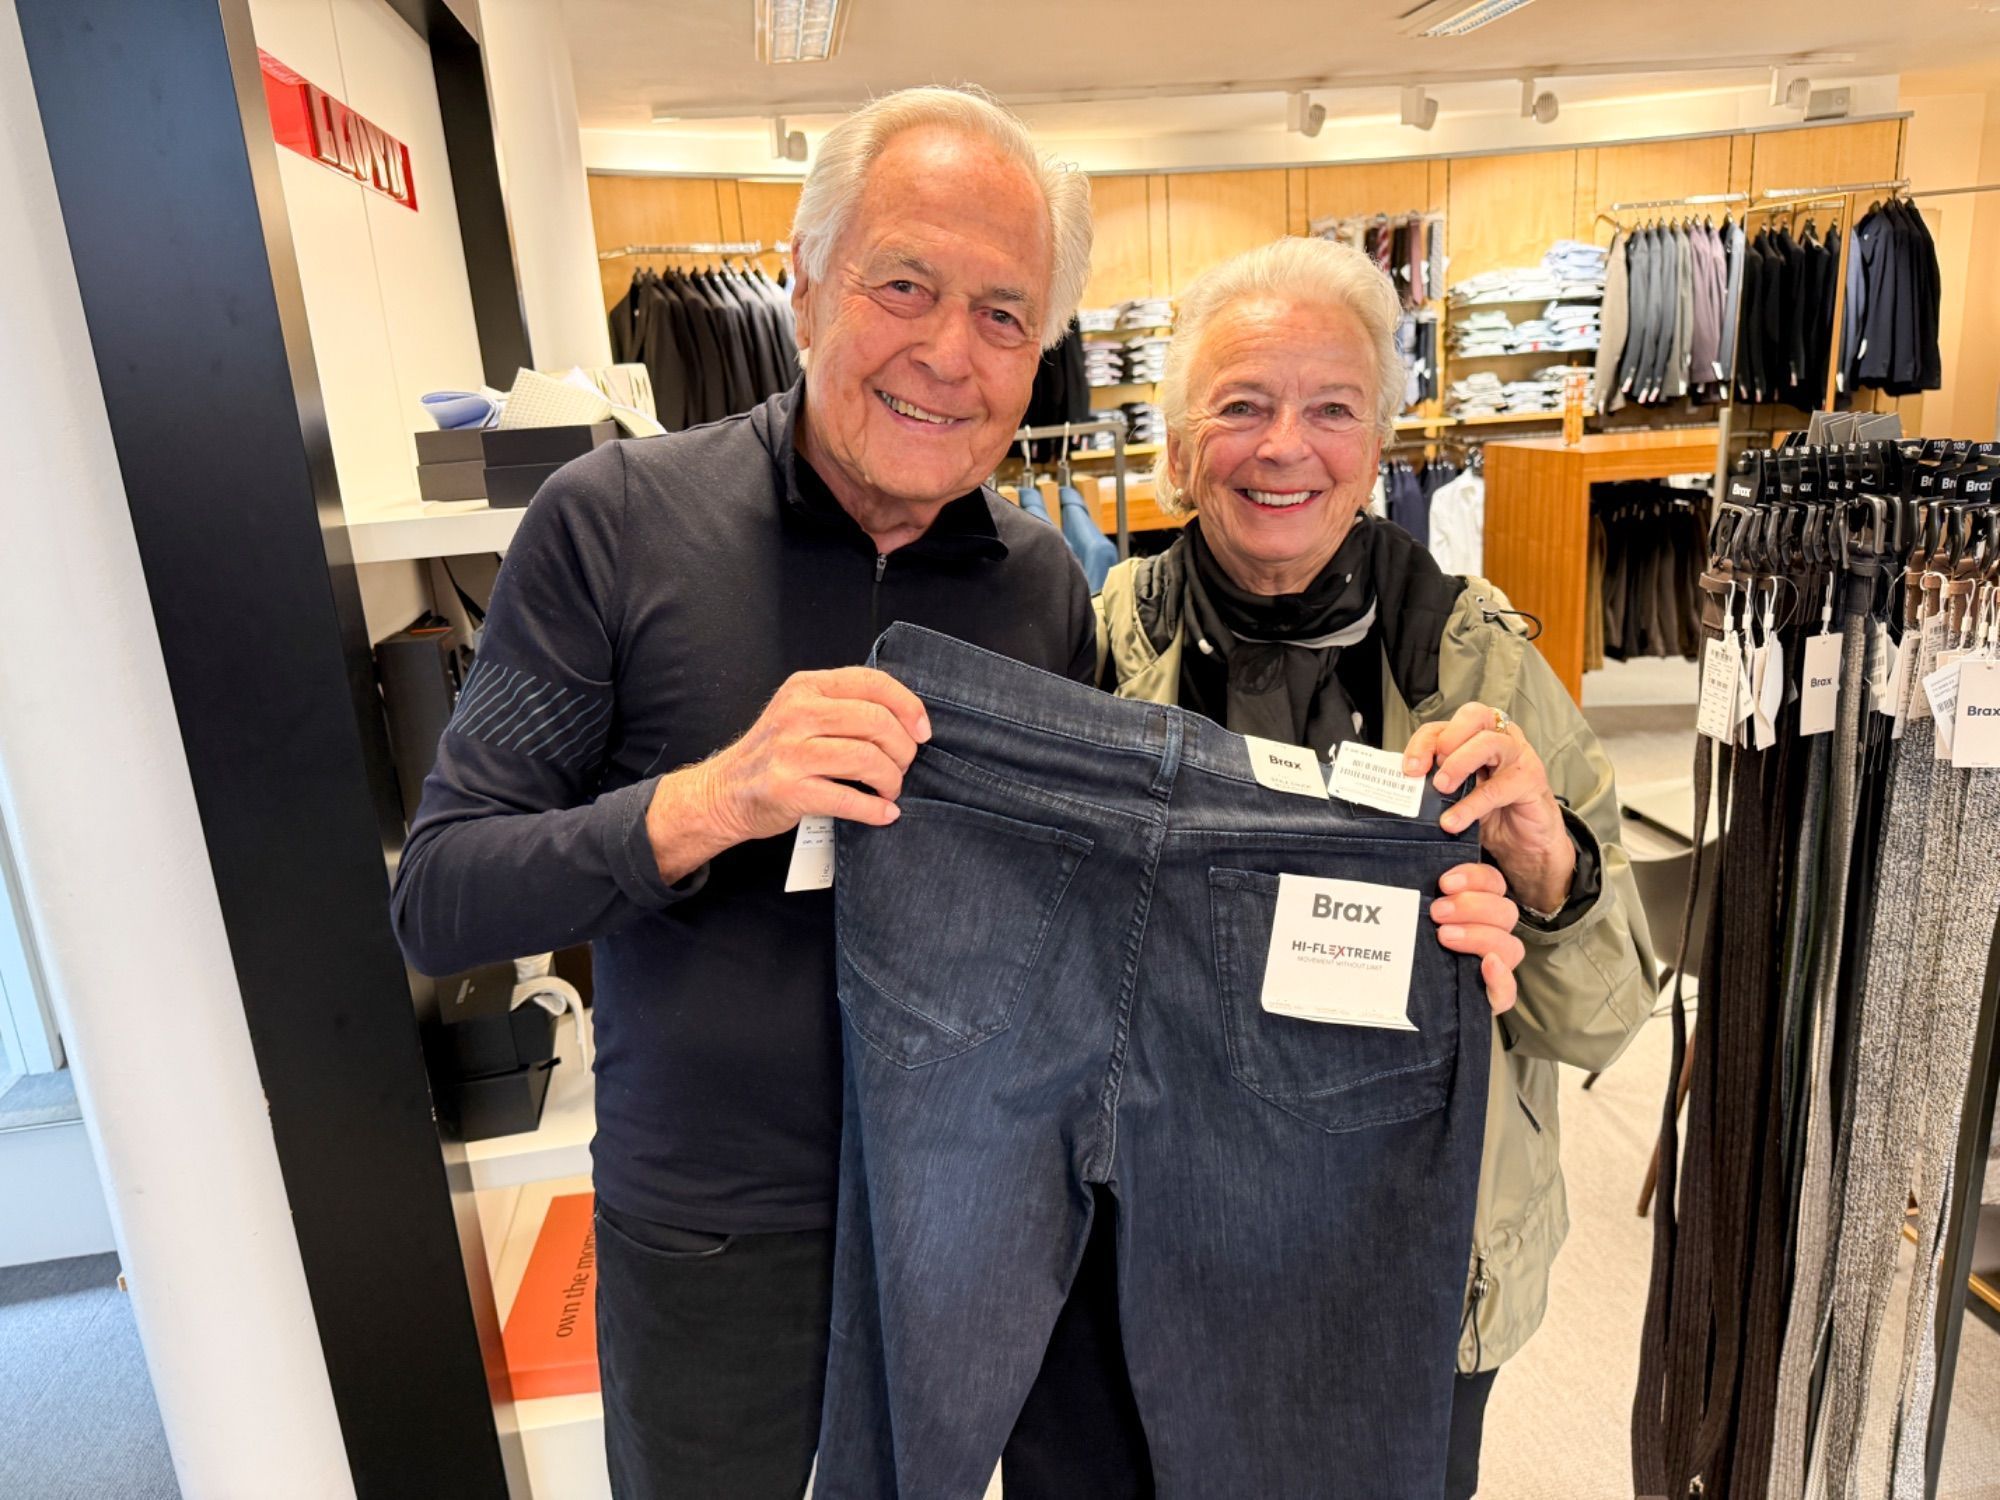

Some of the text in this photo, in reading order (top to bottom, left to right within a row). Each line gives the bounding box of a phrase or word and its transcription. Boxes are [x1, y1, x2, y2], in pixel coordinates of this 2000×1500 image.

[1979, 443, 1993, 452] 100
[1920, 475, 1935, 487] Br
[1732, 483, 1752, 498] Brax
[1810, 677, 1833, 688] Brax
[1269, 754, 1302, 770] Brax
[1312, 893, 1383, 925] Brax
[1292, 940, 1392, 962] HI-FLEXTREME
[1336, 960, 1366, 969] WITHOUT
[563, 1273, 590, 1300] the
[556, 1301, 580, 1338] own
